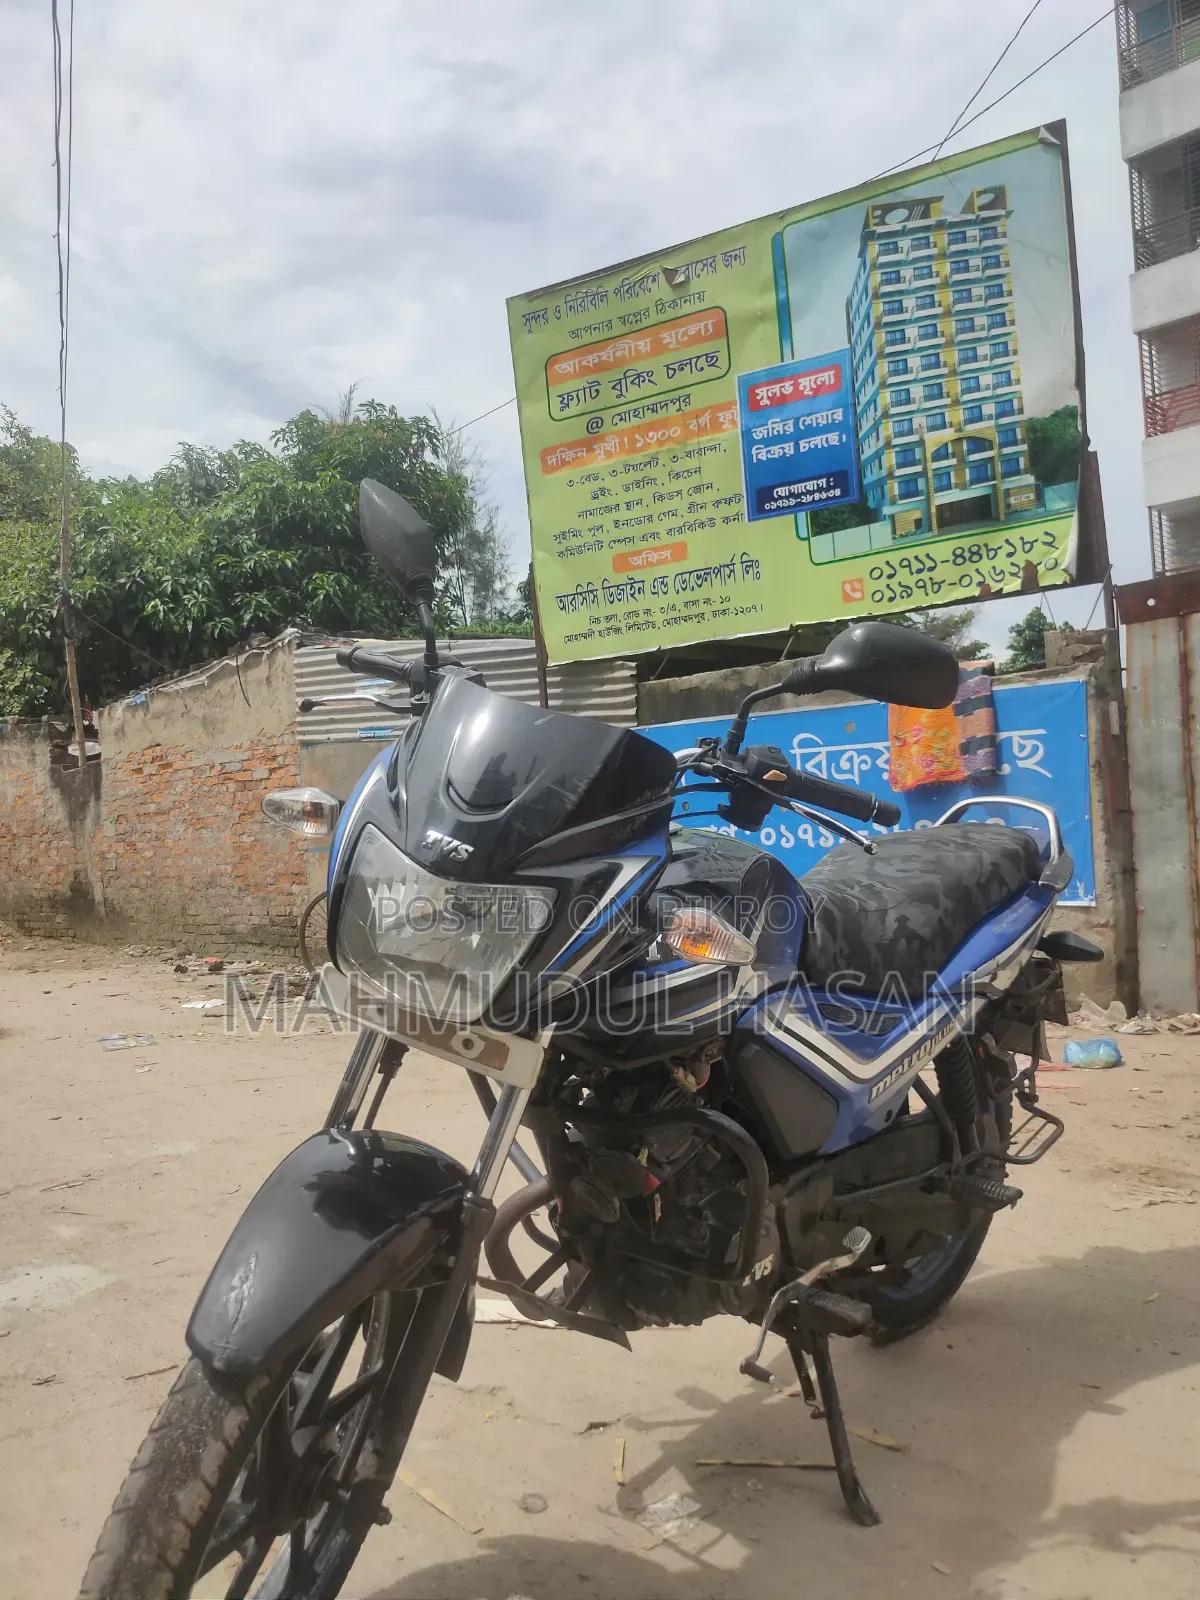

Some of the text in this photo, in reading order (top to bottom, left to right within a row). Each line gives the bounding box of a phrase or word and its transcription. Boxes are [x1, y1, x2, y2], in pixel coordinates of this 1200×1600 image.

[522, 308, 548, 335] সুন্দর
[553, 305, 561, 320] ও
[564, 286, 608, 318] নিরিবিলি
[613, 271, 660, 303] পরিবেশে
[721, 246, 746, 269] জন্য
[568, 290, 706, 340] আপনার স্বপ্নের ঠিকানায়
[659, 319, 716, 349] মূল্যে
[556, 350, 722, 412] ফ্ল্যাট বুকিং চলছে
[755, 370, 835, 406] সুলভ মূল্যে
[586, 393, 692, 435] @ মোহাম্মদপুর
[634, 426, 680, 448] ১৩০০
[686, 409, 711, 431] বর্গ
[751, 408, 844, 440] জমির শেয়ার
[751, 442, 794, 463] বিক্রয়
[668, 466, 701, 483] কিচেন
[773, 478, 827, 498] যোগাযোগ
[577, 503, 620, 520] নামাজের
[764, 488, 841, 510] ০১৭১১-২৮৪৬৩৪
[553, 528, 583, 544] সুইমিং
[613, 514, 653, 530] ইনডোর
[711, 493, 744, 509] রুফট
[556, 510, 745, 559] কমিউনিটি স্পেস এবং বারবিকিউ কর্না
[628, 549, 672, 566] অফিস
[869, 531, 1060, 581] ০১৭১১-৪৪৮১৮২
[555, 552, 761, 615] আরসিসি ডিজাইন এন্ড ডেভেলপার্স লিঃ
[871, 557, 1058, 603] ০১৯৭৮-০১৬২০
[623, 609, 640, 621] রোড
[683, 599, 700, 610] বাসা
[598, 625, 624, 638] হাউজিং
[422, 829, 475, 862] TVS
